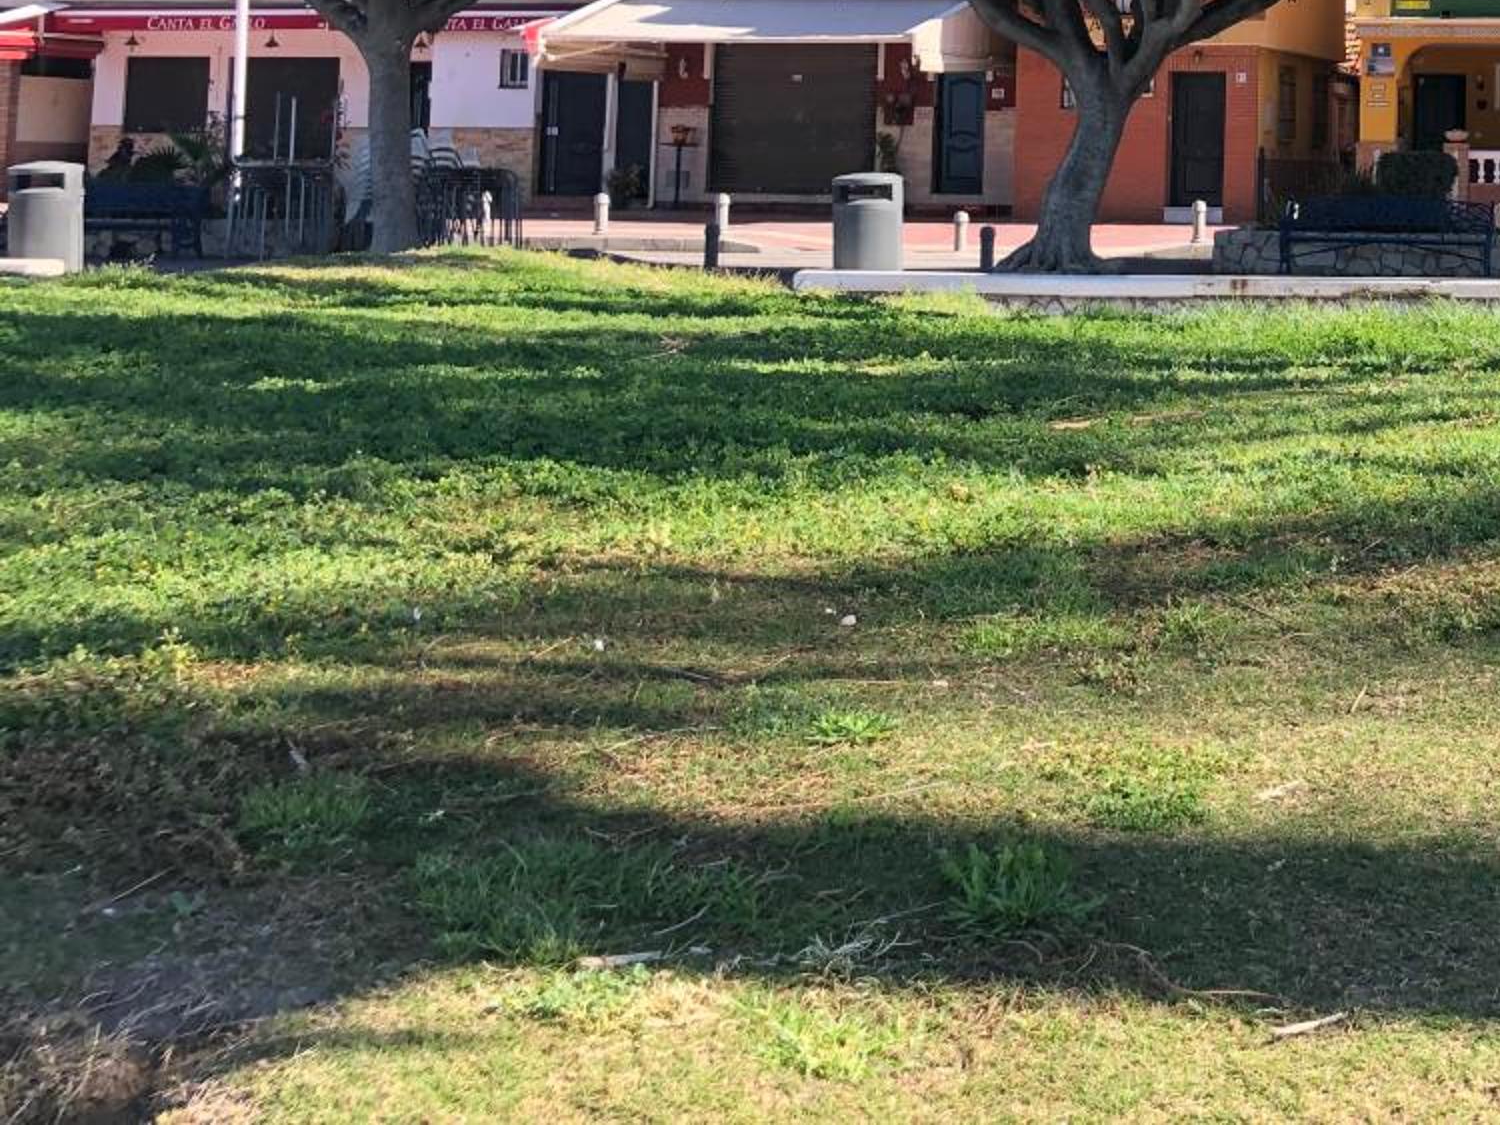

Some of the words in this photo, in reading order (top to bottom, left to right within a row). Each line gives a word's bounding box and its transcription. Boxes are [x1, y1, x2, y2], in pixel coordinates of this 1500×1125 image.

[147, 16, 193, 30] CANTA
[199, 18, 213, 30] EL
[472, 17, 487, 30] EL
